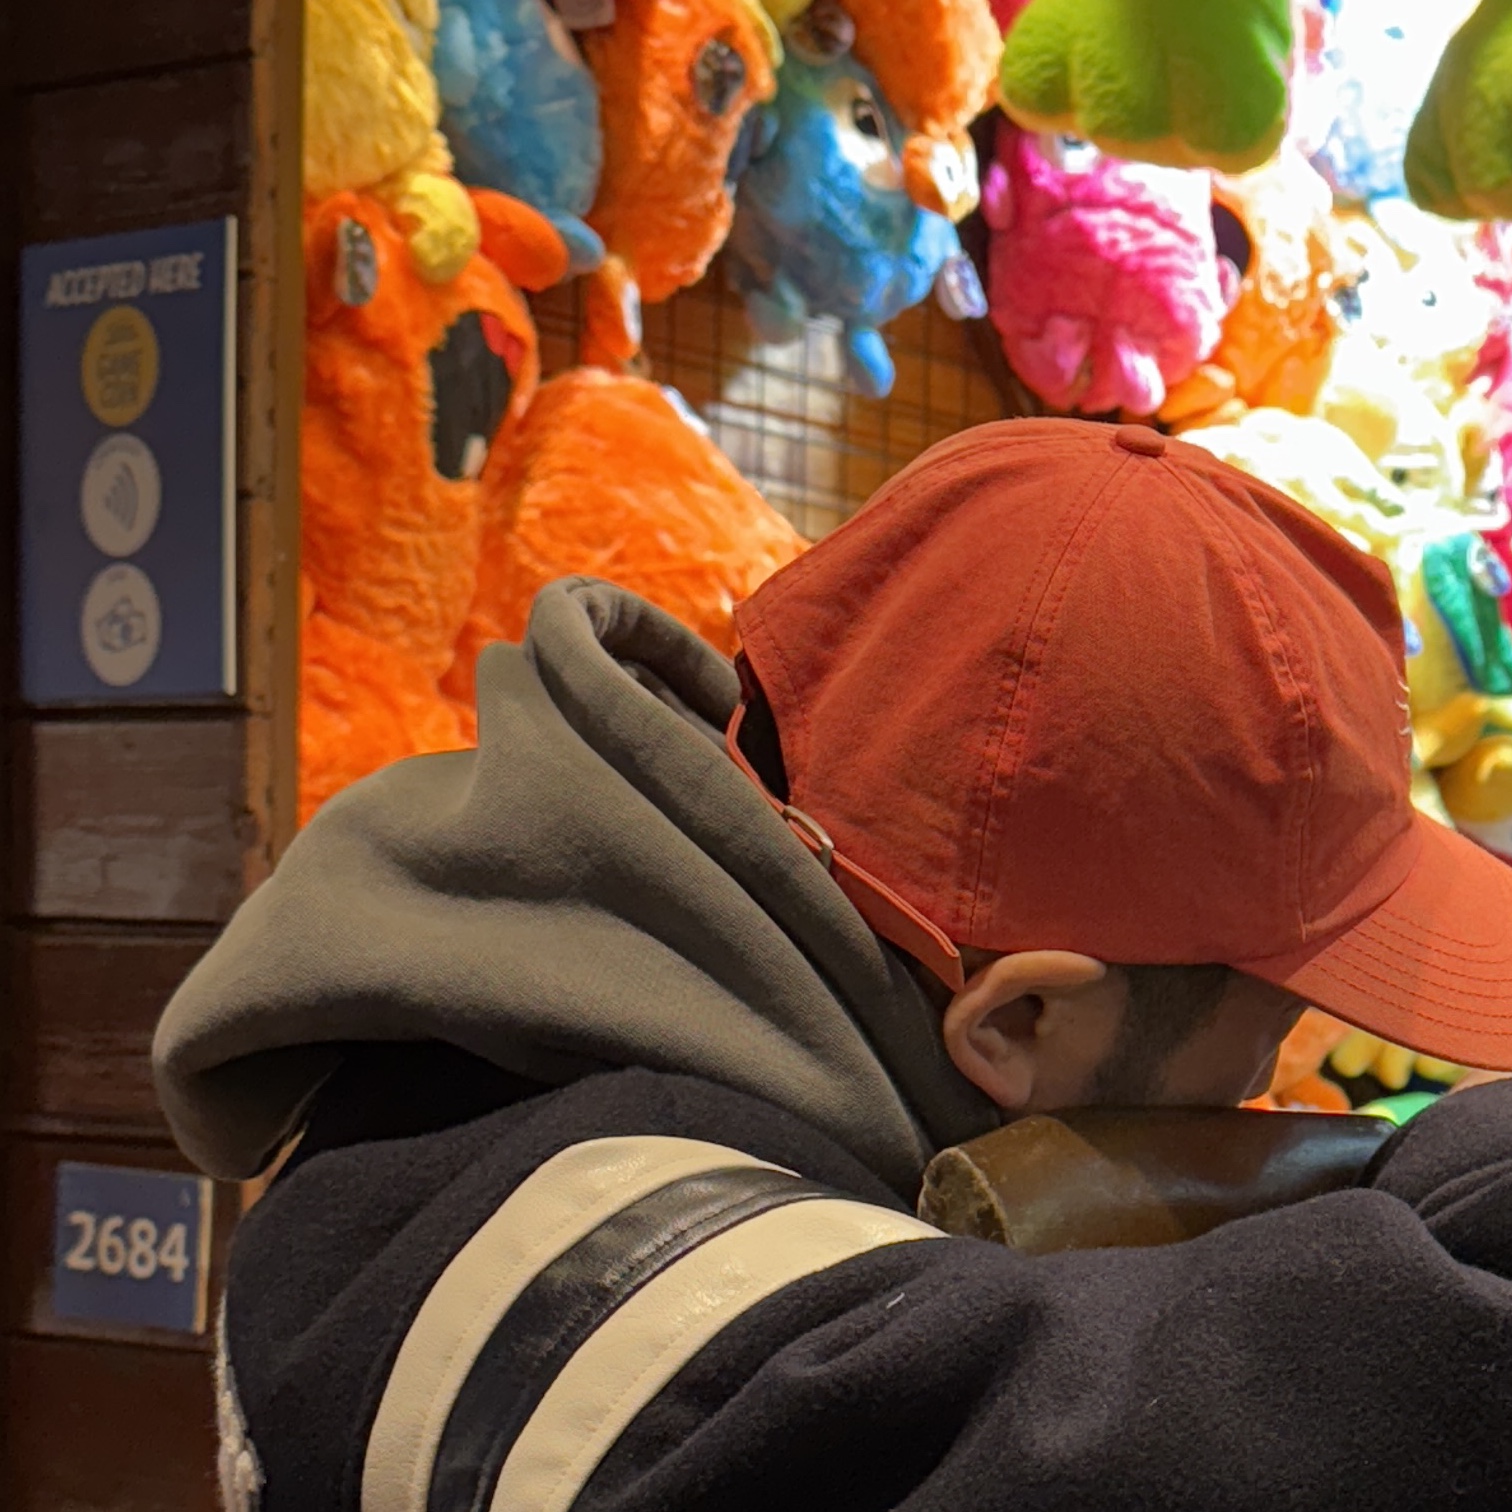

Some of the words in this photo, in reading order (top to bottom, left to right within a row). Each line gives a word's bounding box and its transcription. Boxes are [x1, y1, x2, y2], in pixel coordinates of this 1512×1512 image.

[46, 260, 145, 308] ACCEPTED
[149, 252, 204, 293] HERE
[65, 1210, 189, 1283] 2684
